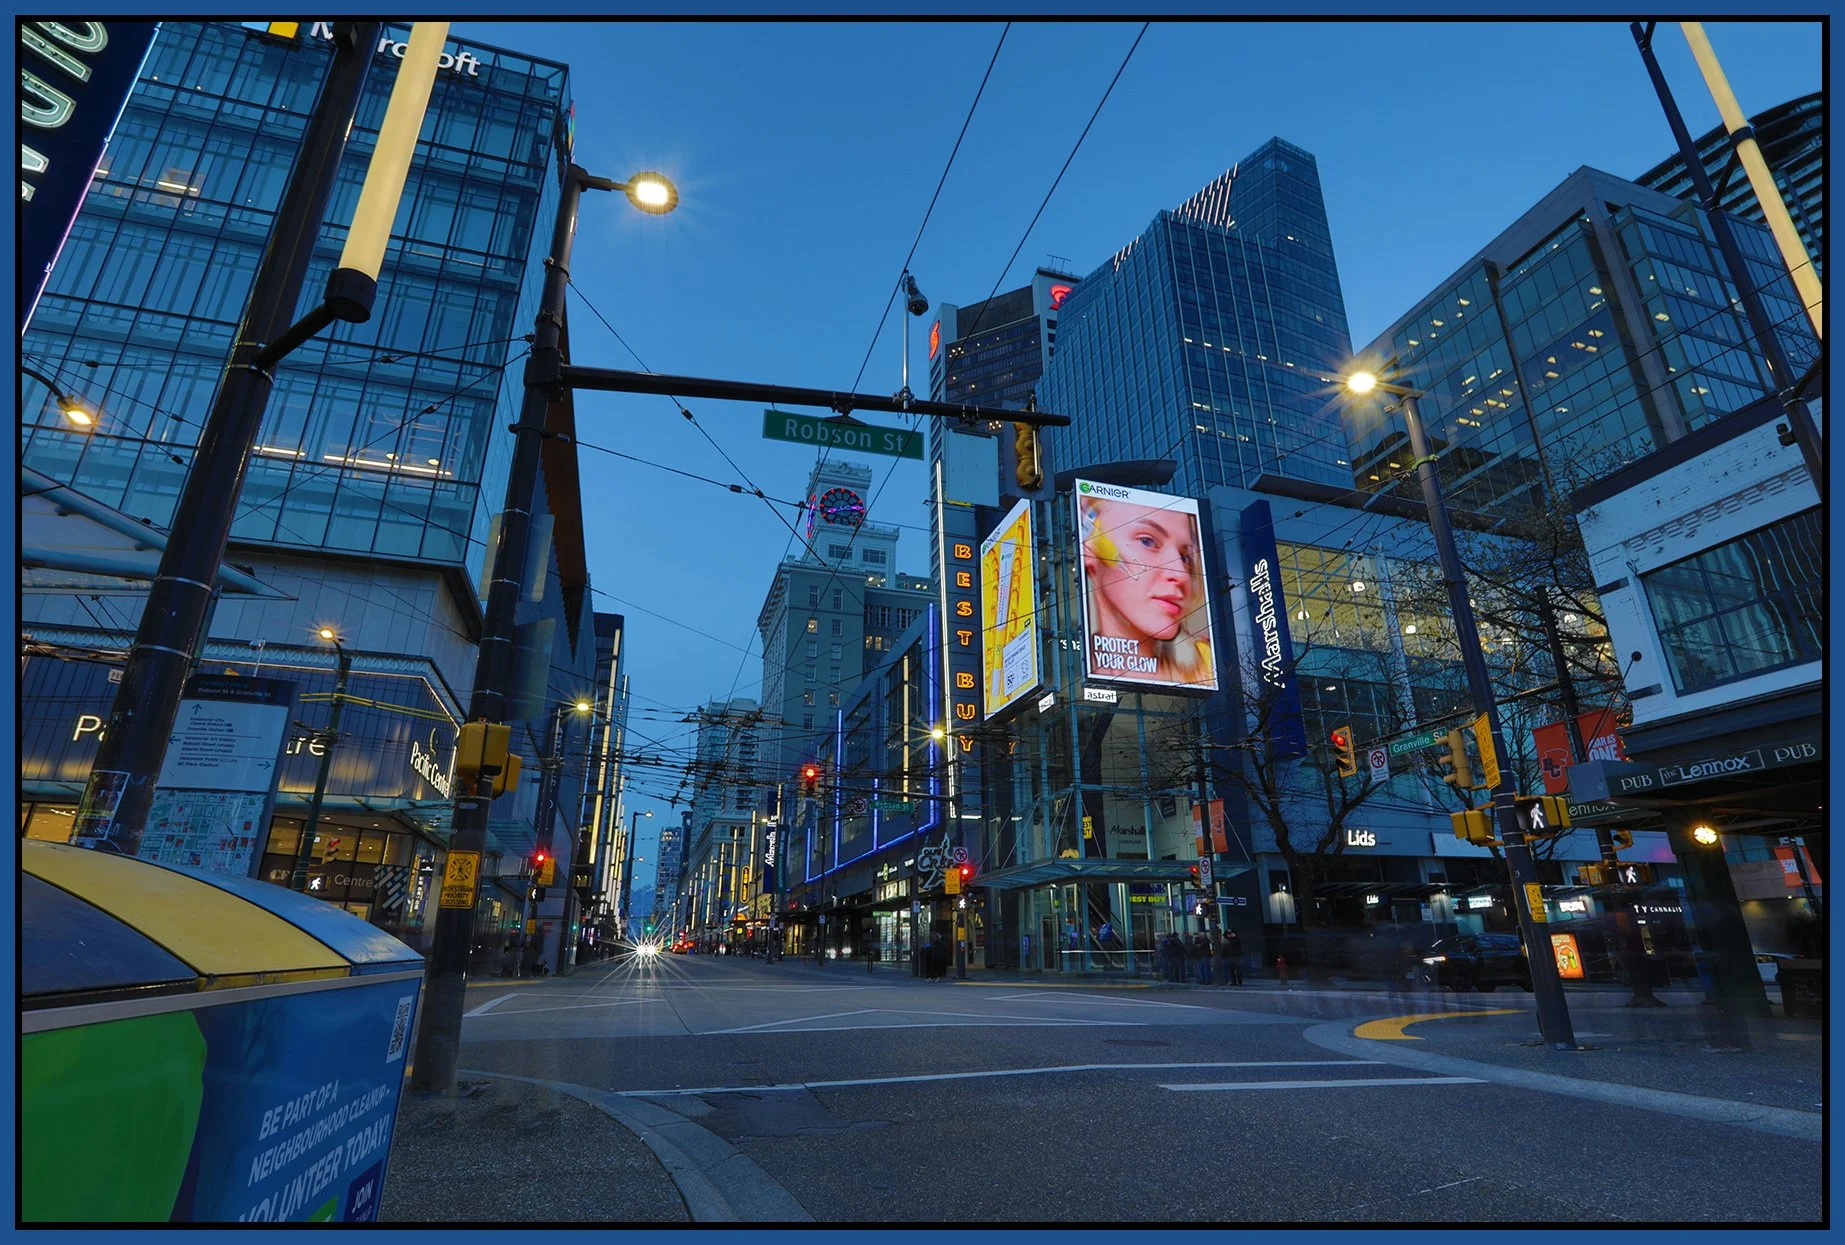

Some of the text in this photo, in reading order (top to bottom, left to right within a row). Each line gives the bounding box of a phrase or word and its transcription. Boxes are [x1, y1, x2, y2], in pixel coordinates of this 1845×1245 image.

[785, 418, 904, 452] Robson St
[1250, 558, 1286, 689] Marshalls
[953, 543, 976, 752] BEST BUY
[1094, 634, 1139, 655] PROTECT
[1094, 651, 1158, 673] YOUR GLOW
[1087, 690, 1115, 701] astral
[410, 741, 432, 781] Pacific
[1392, 736, 1430, 754] Granville
[1774, 743, 1816, 762] PUB
[1620, 756, 1750, 791] PUB the Lennox
[1110, 824, 1146, 836] Marshall
[1347, 829, 1376, 847] Lids
[334, 873, 374, 888] Centre
[258, 1078, 340, 1141] BE PART OF A
[248, 1104, 349, 1187] NEIGHBOURHOOD
[349, 1083, 386, 1122] CLEANUP
[344, 1113, 390, 1171] TODAY!
[352, 1179, 374, 1214] JOIN
